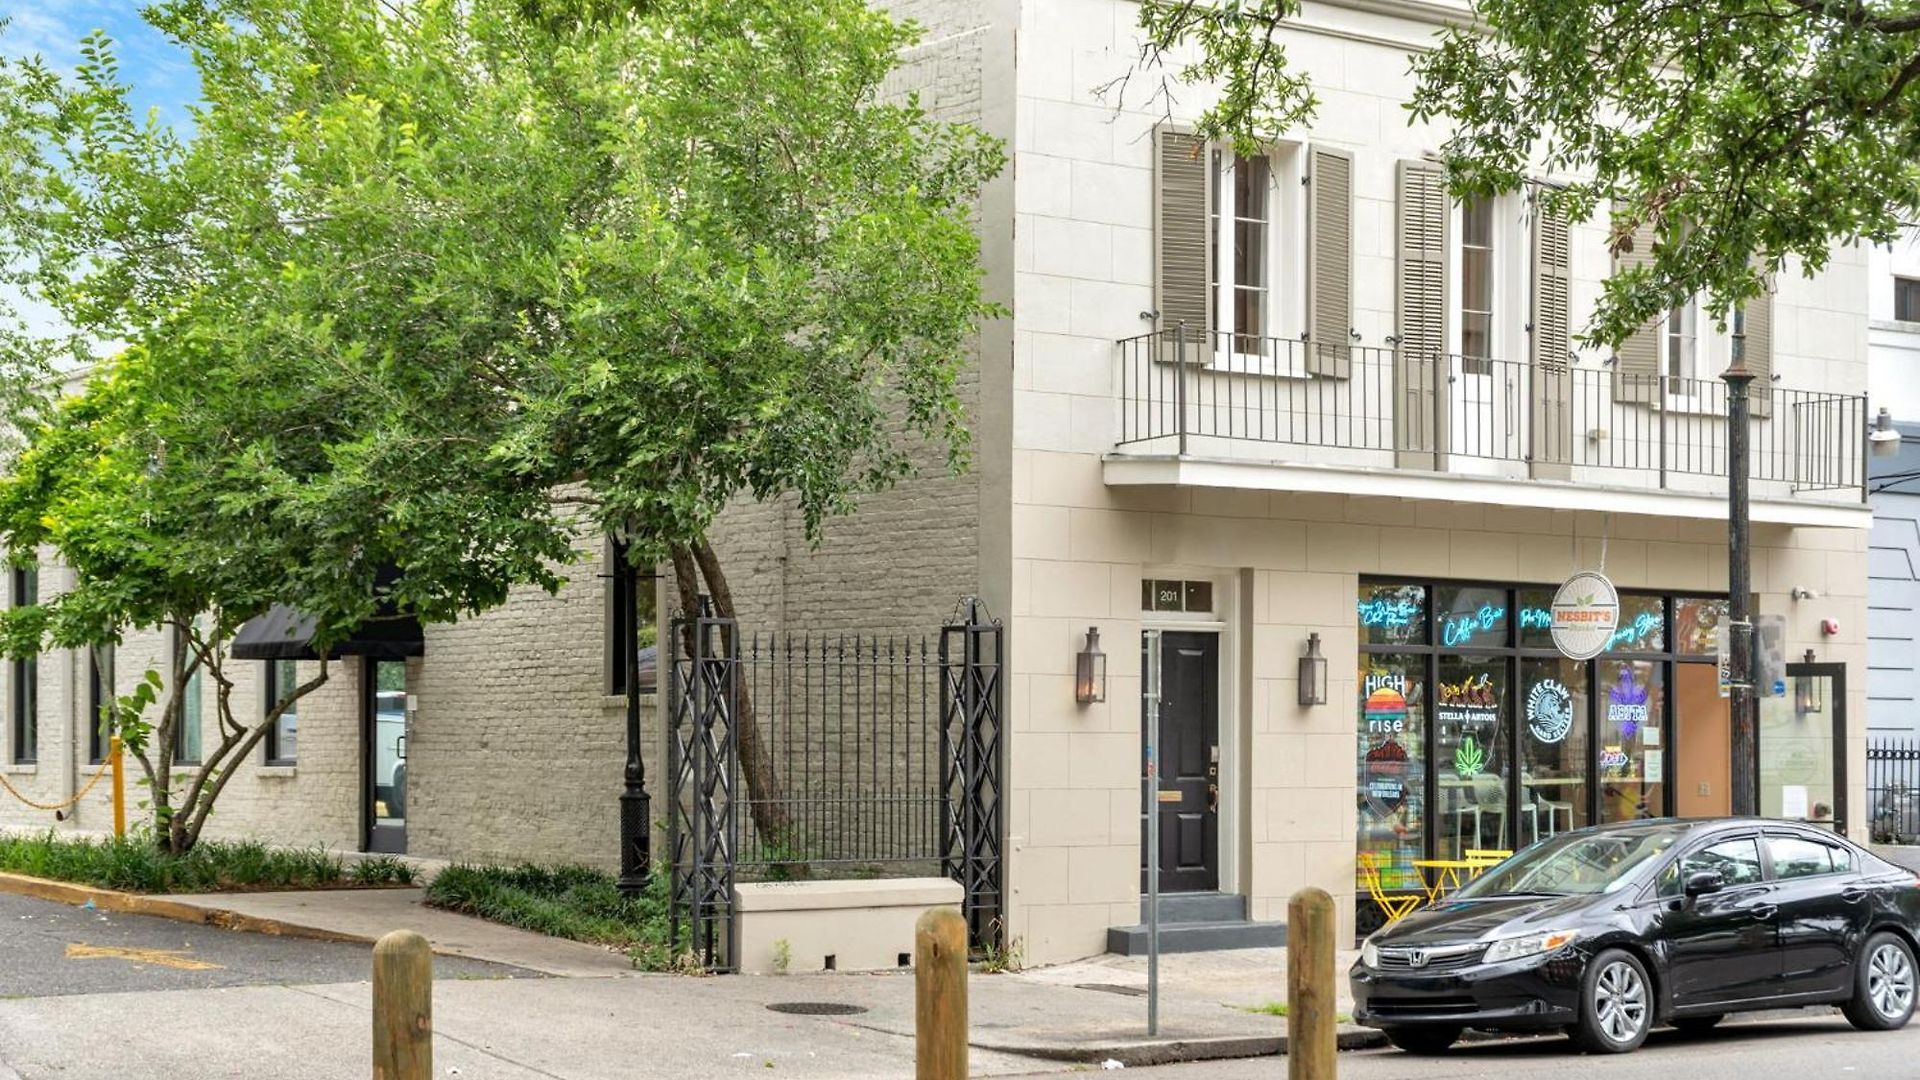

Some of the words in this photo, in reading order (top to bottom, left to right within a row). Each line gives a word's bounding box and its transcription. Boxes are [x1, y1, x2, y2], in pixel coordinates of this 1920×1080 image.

[1160, 590, 1177, 601] 201
[1556, 610, 1611, 622] NESBIT'S
[1445, 618, 1480, 645] Coffee
[1365, 675, 1405, 699] HIGH
[1527, 682, 1544, 720] WHITE
[1543, 679, 1570, 700] CLAW
[1438, 712, 1464, 720] STELLA
[1470, 713, 1497, 721] ARTOIS
[1369, 720, 1403, 733] rise
